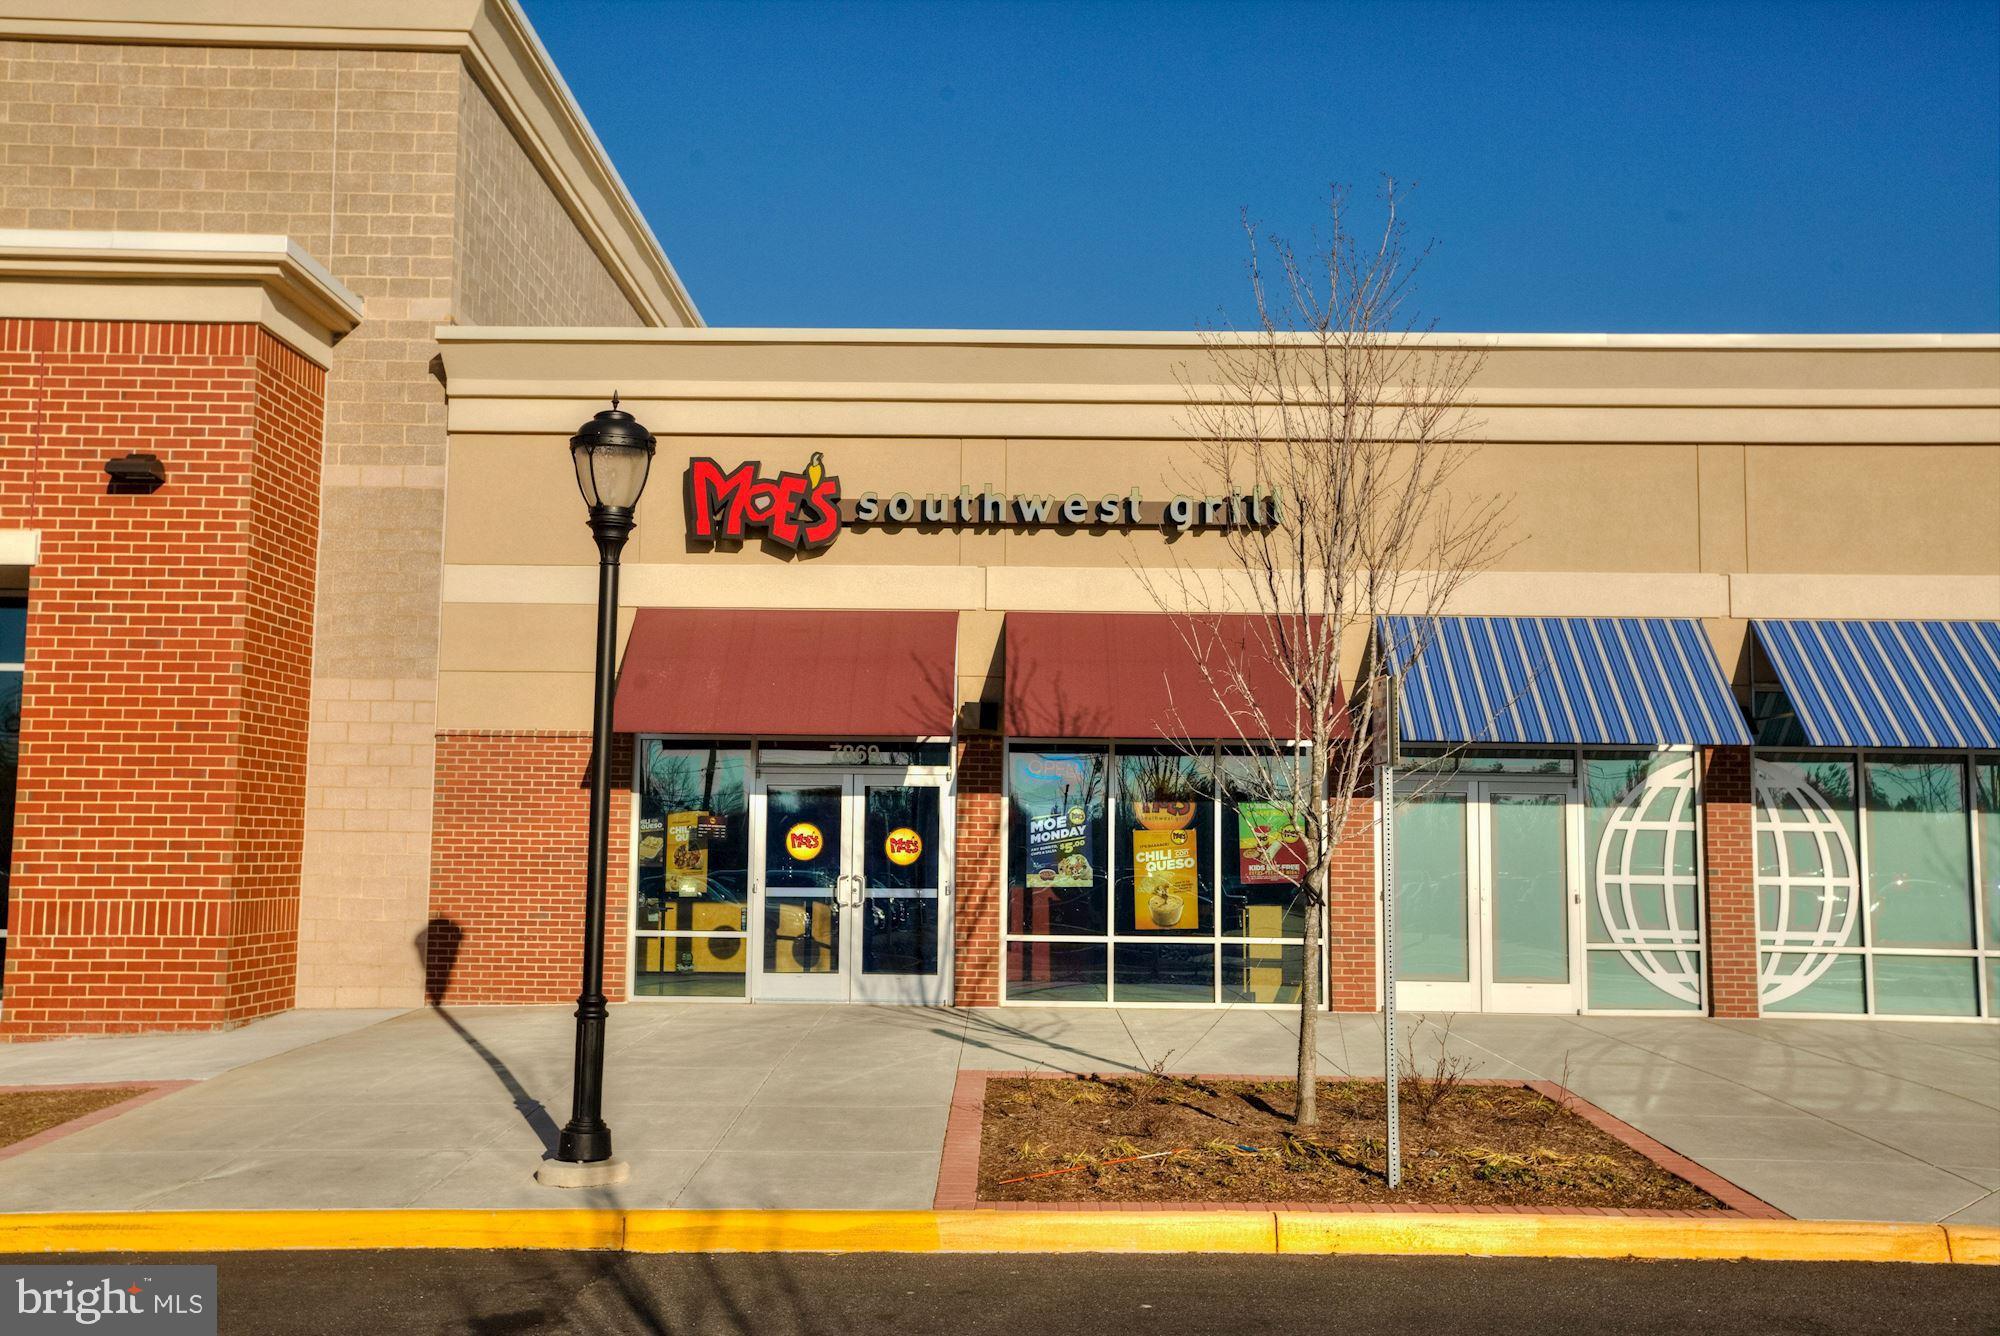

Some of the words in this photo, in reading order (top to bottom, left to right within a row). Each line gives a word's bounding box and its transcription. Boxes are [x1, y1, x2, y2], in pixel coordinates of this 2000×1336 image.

[858, 483, 1142, 523] southwest
[1170, 484, 1285, 532] grill
[1030, 816, 1067, 833] MOE
[1030, 825, 1086, 844] MONDAY
[1059, 840, 1086, 853] $5.00
[1135, 849, 1172, 863] CHILI
[1145, 857, 1195, 872] QUESO
